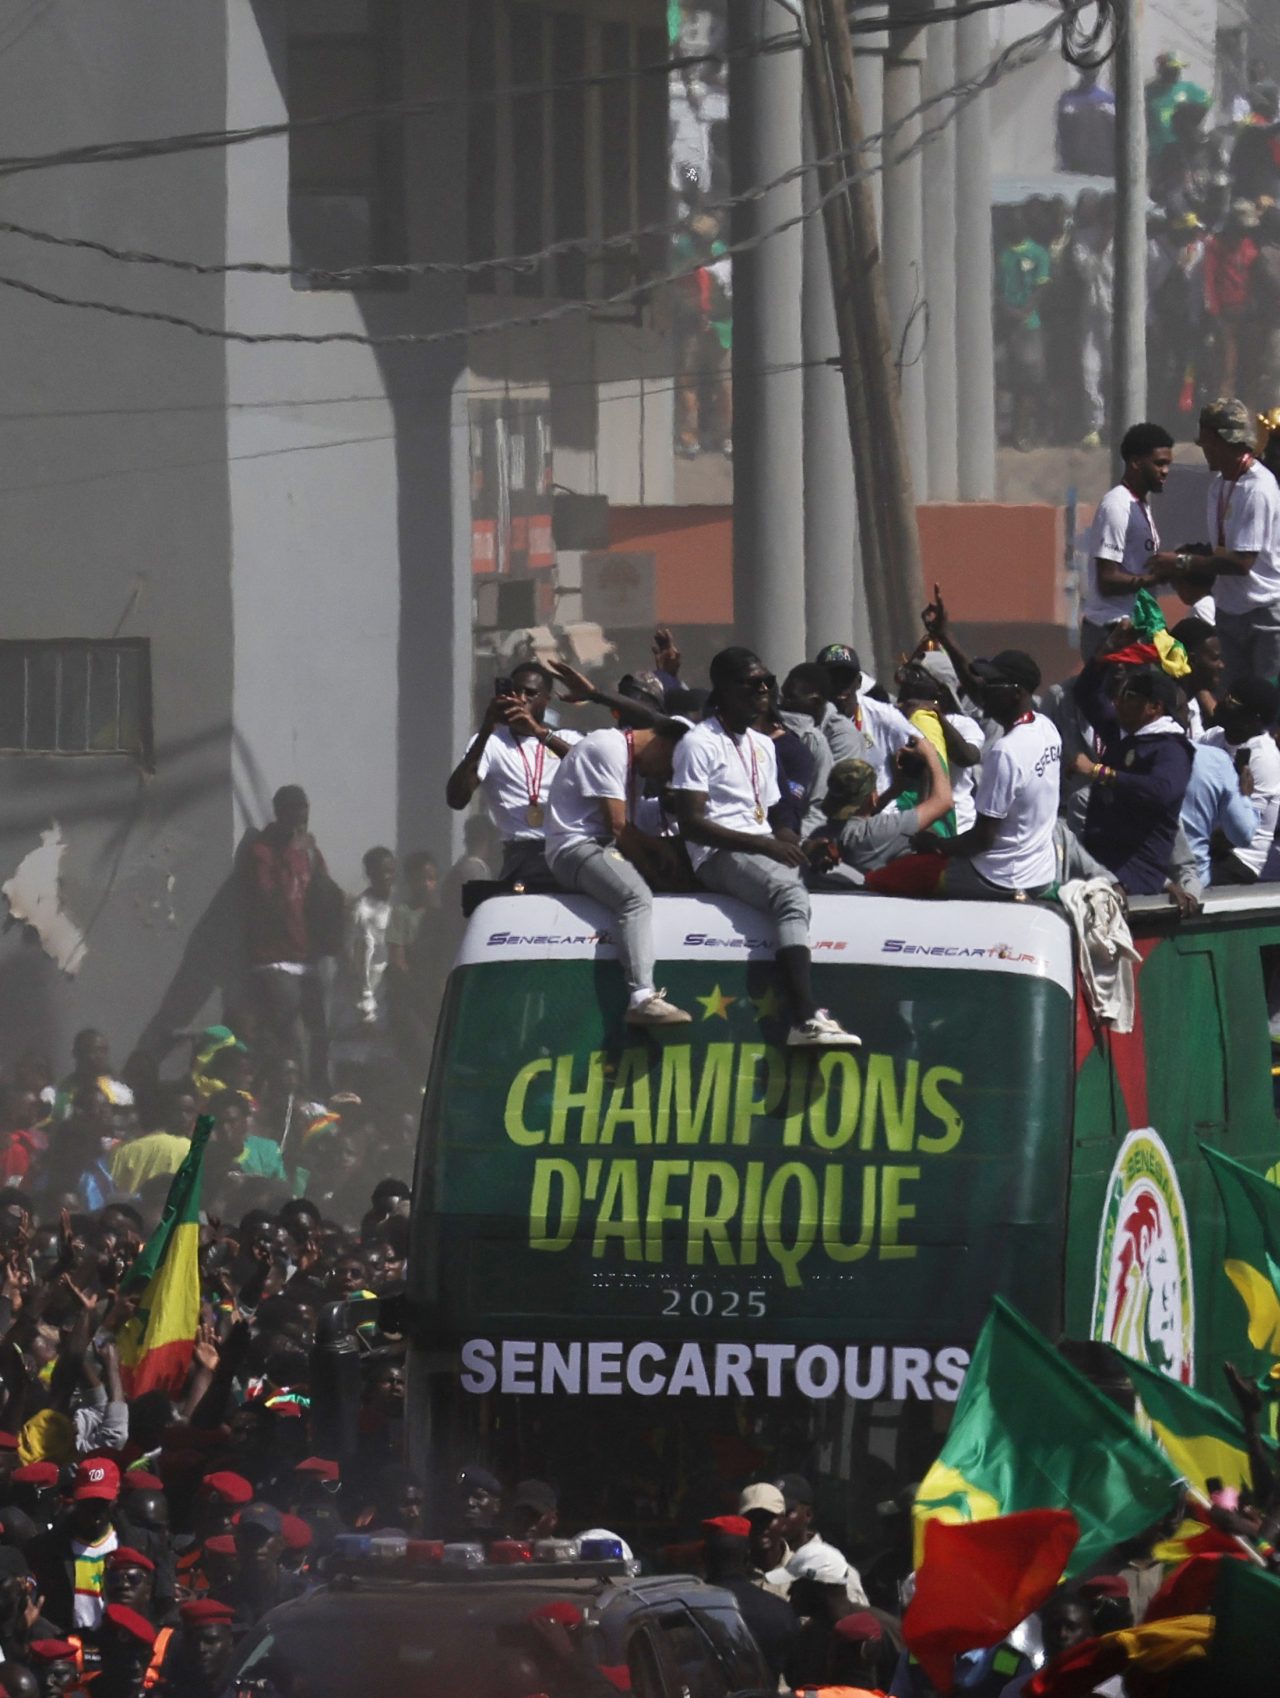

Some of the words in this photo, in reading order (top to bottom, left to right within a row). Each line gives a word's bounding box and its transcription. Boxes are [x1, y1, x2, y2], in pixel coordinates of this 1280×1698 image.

[503, 1042, 965, 1154] CHAMPIONS
[528, 1157, 921, 1288] D'AFRIQUE
[660, 1288, 767, 1319] 2025
[460, 1338, 971, 1402] SENECARTOURS
